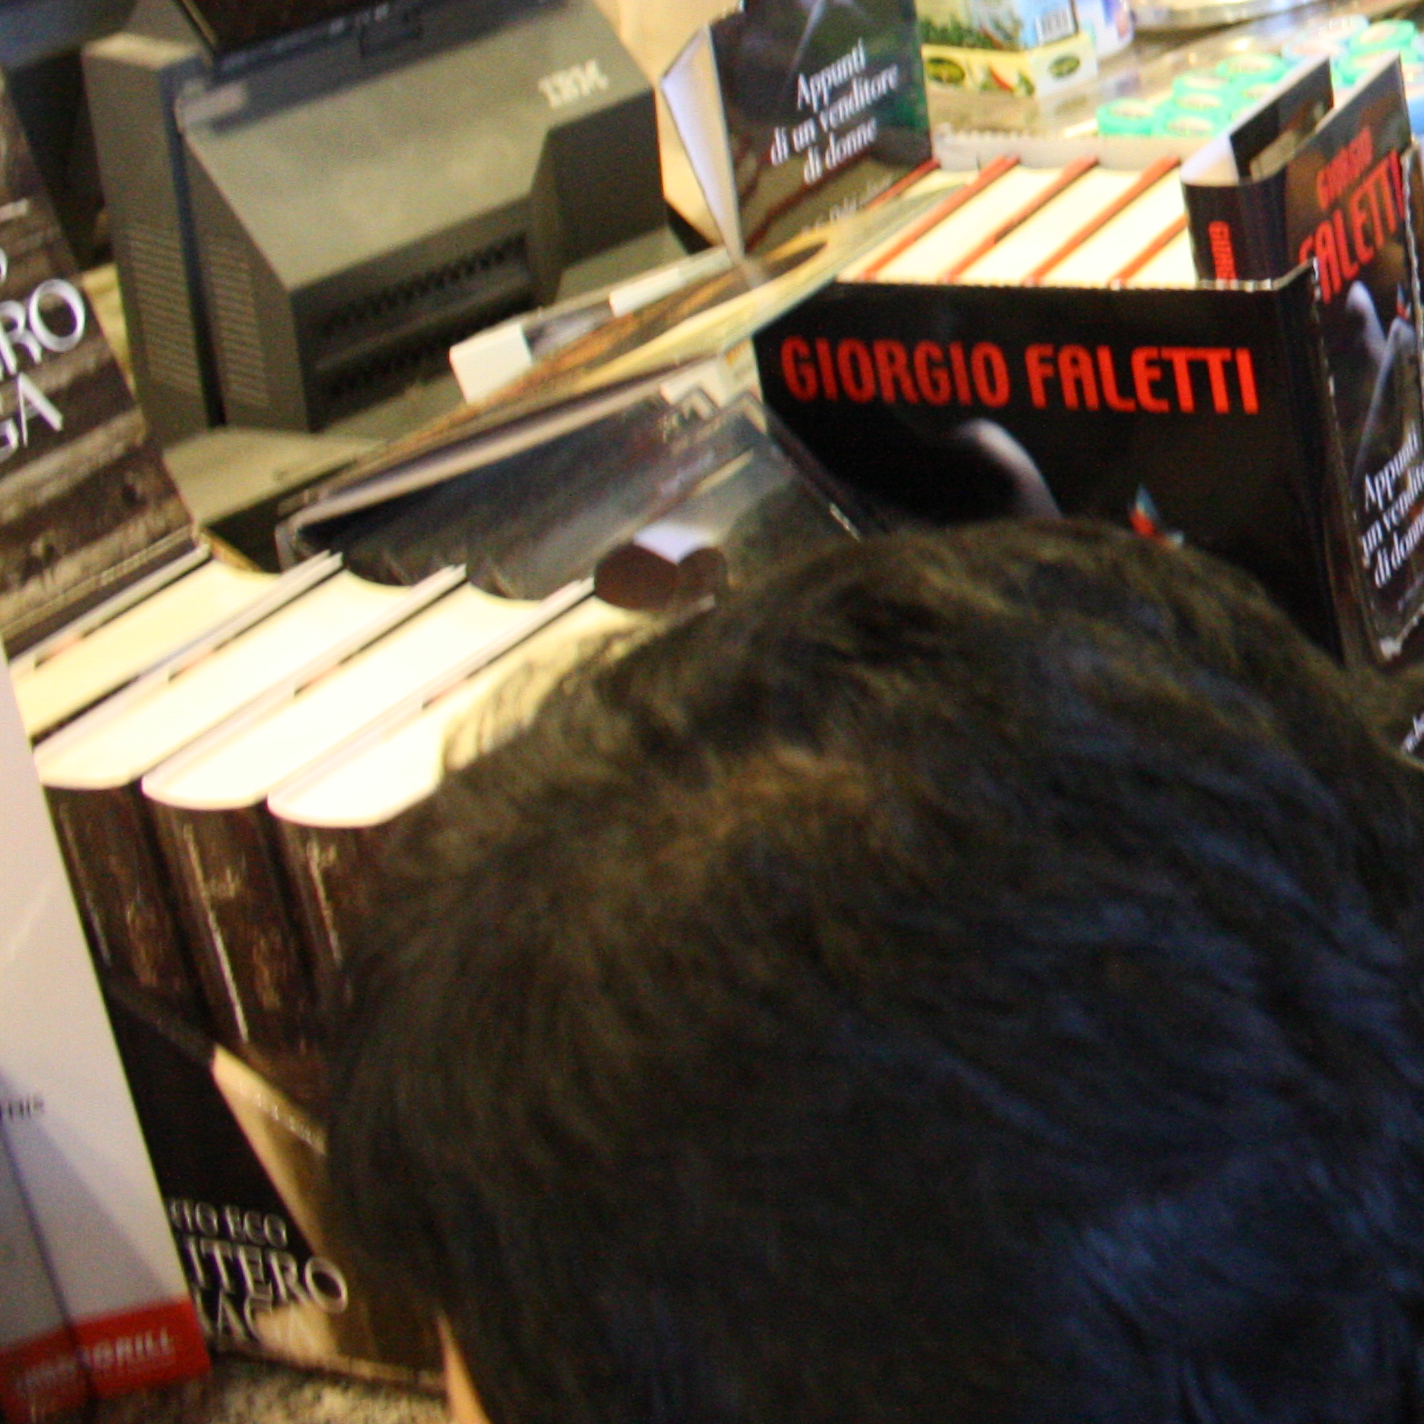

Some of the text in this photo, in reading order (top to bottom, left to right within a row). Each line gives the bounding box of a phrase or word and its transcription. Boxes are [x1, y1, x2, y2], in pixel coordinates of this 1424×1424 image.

[537, 58, 610, 109] IBM
[769, 62, 901, 167] di un venditore
[796, 37, 867, 113] Appunti
[803, 114, 879, 185] di donne
[1298, 147, 1406, 305] FALETTI
[779, 337, 1261, 416] GIORGIO FALETTI
[1363, 419, 1420, 513] Appunti
